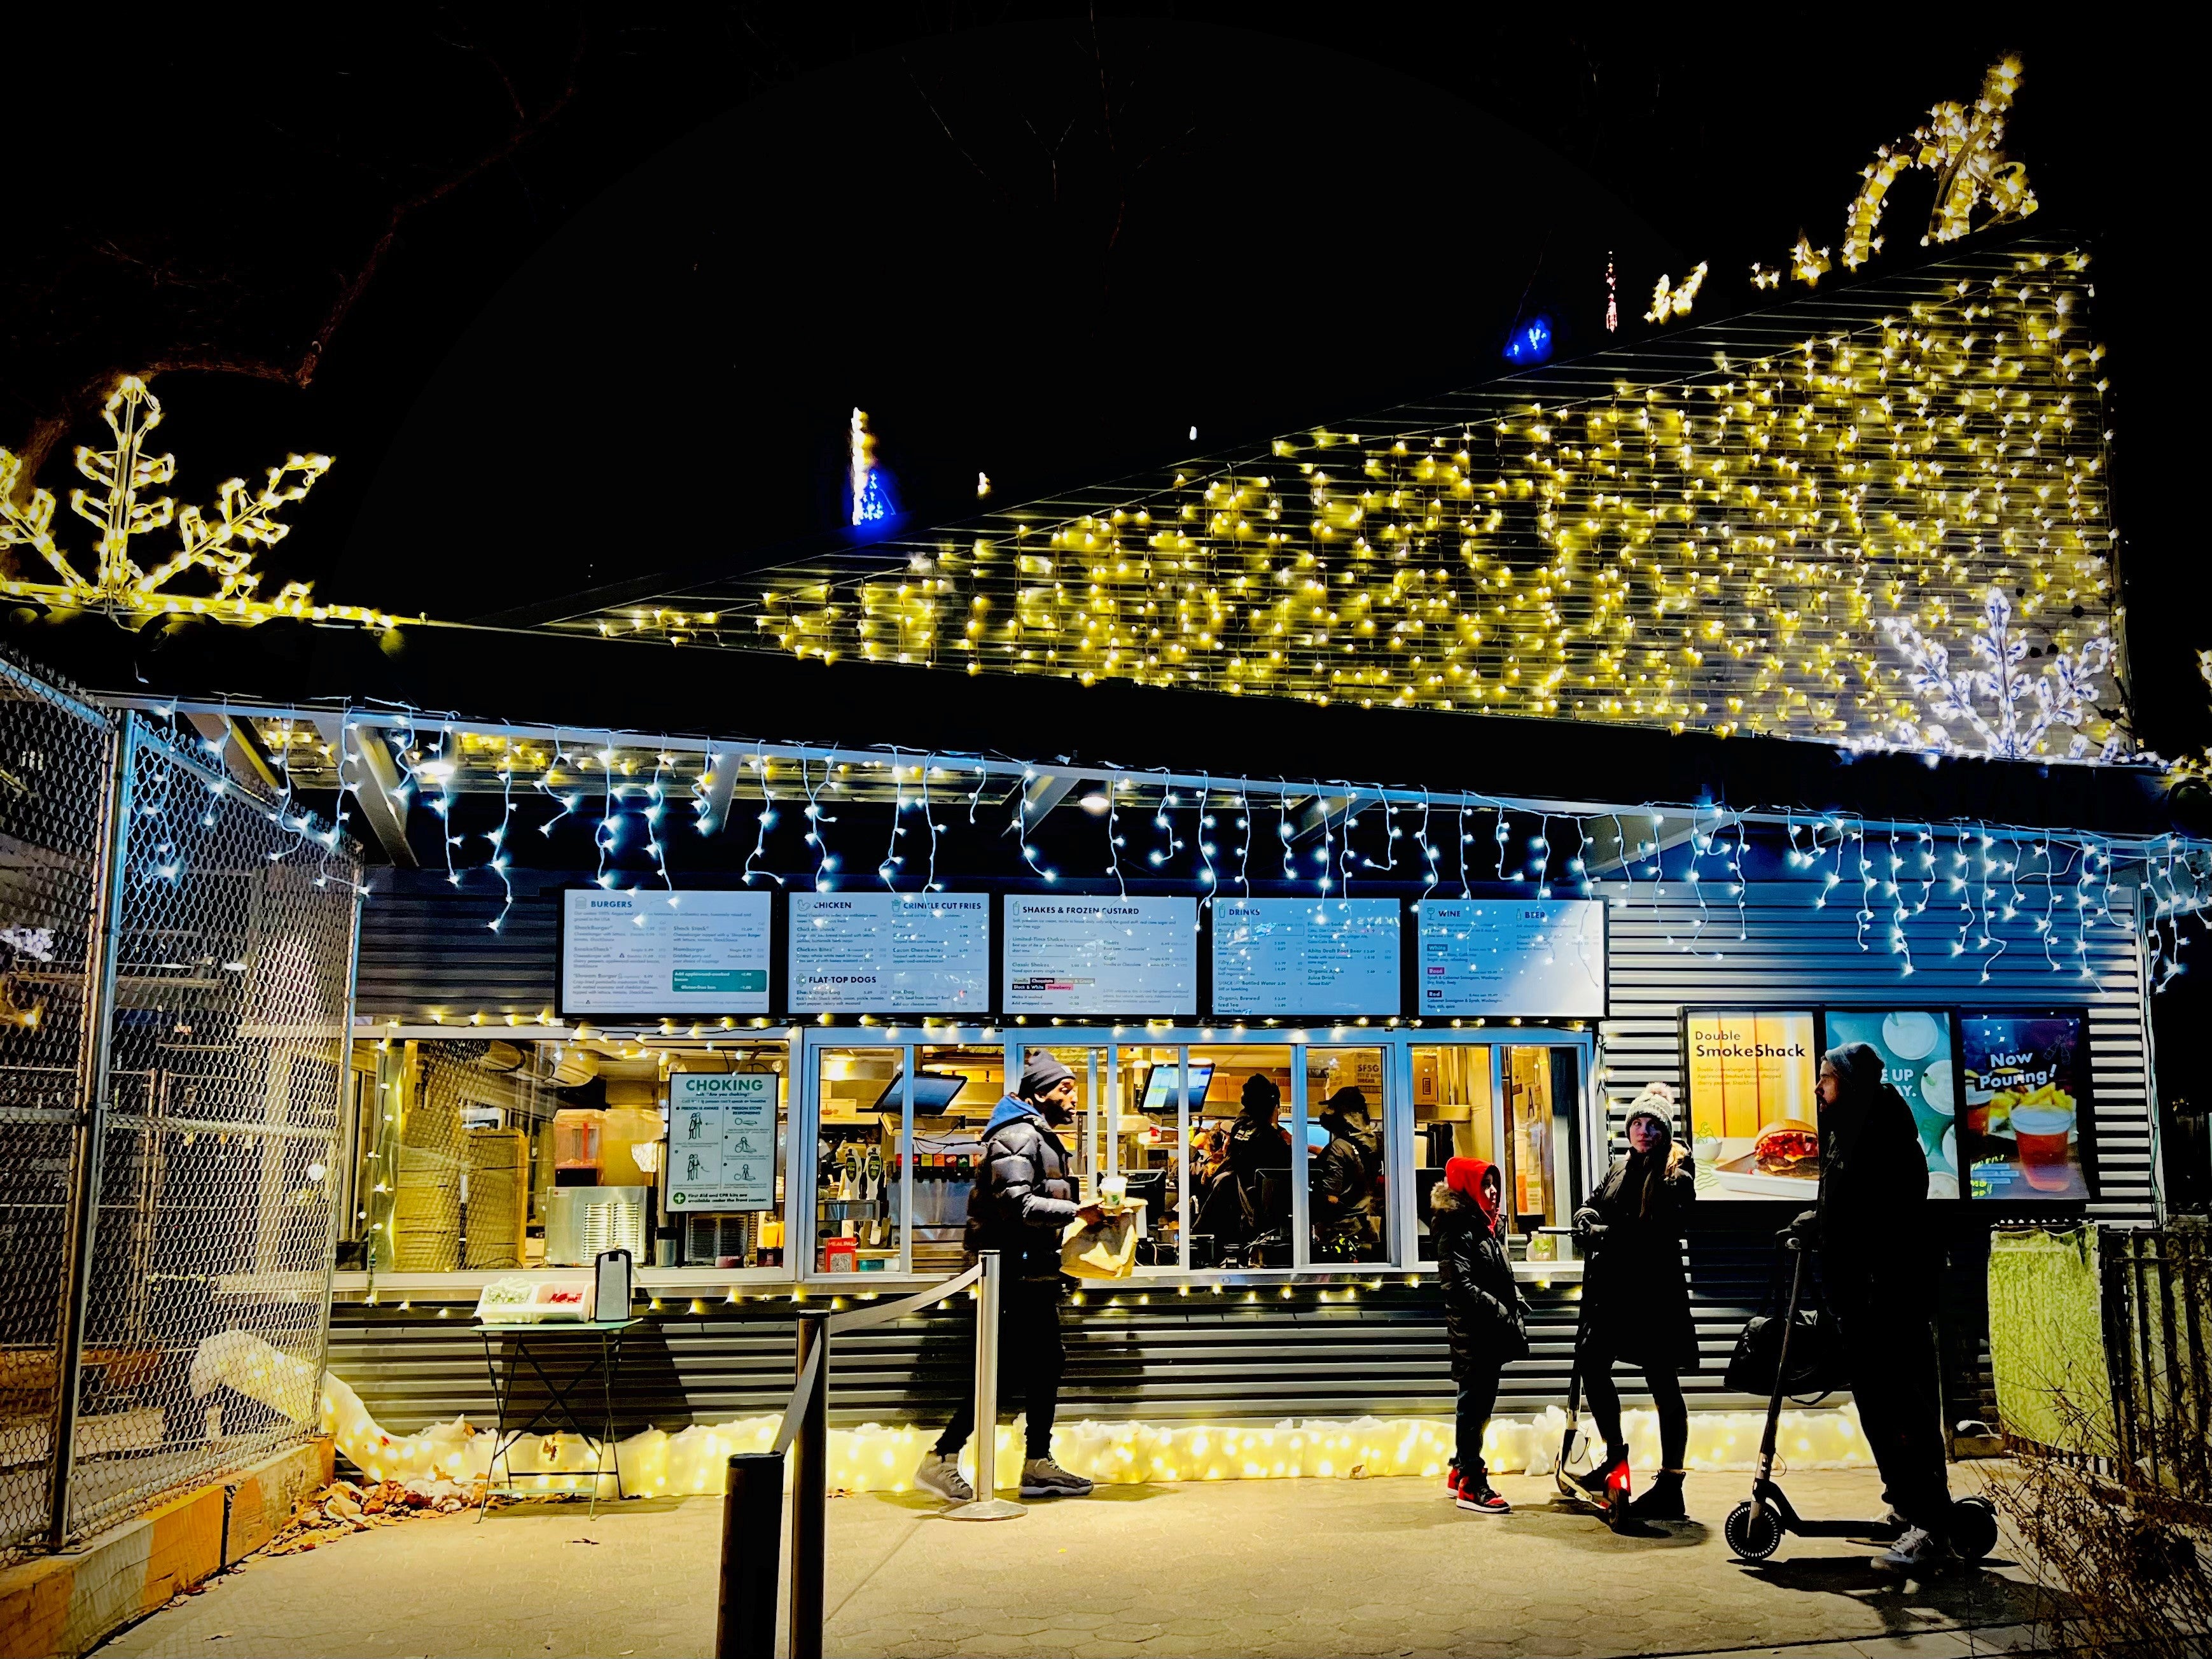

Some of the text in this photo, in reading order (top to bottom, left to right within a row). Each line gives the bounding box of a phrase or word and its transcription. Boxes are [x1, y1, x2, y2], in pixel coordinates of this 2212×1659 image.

[1695, 1030, 1741, 1040] Double
[1697, 1044, 1806, 1057] SmokeShack
[1990, 1053, 2033, 1068] Now
[1357, 1064, 1380, 1072] SFSG
[1892, 1069, 1914, 1082] UP
[1979, 1063, 2057, 1089] Pouring!
[686, 1079, 763, 1091] CHOKING
